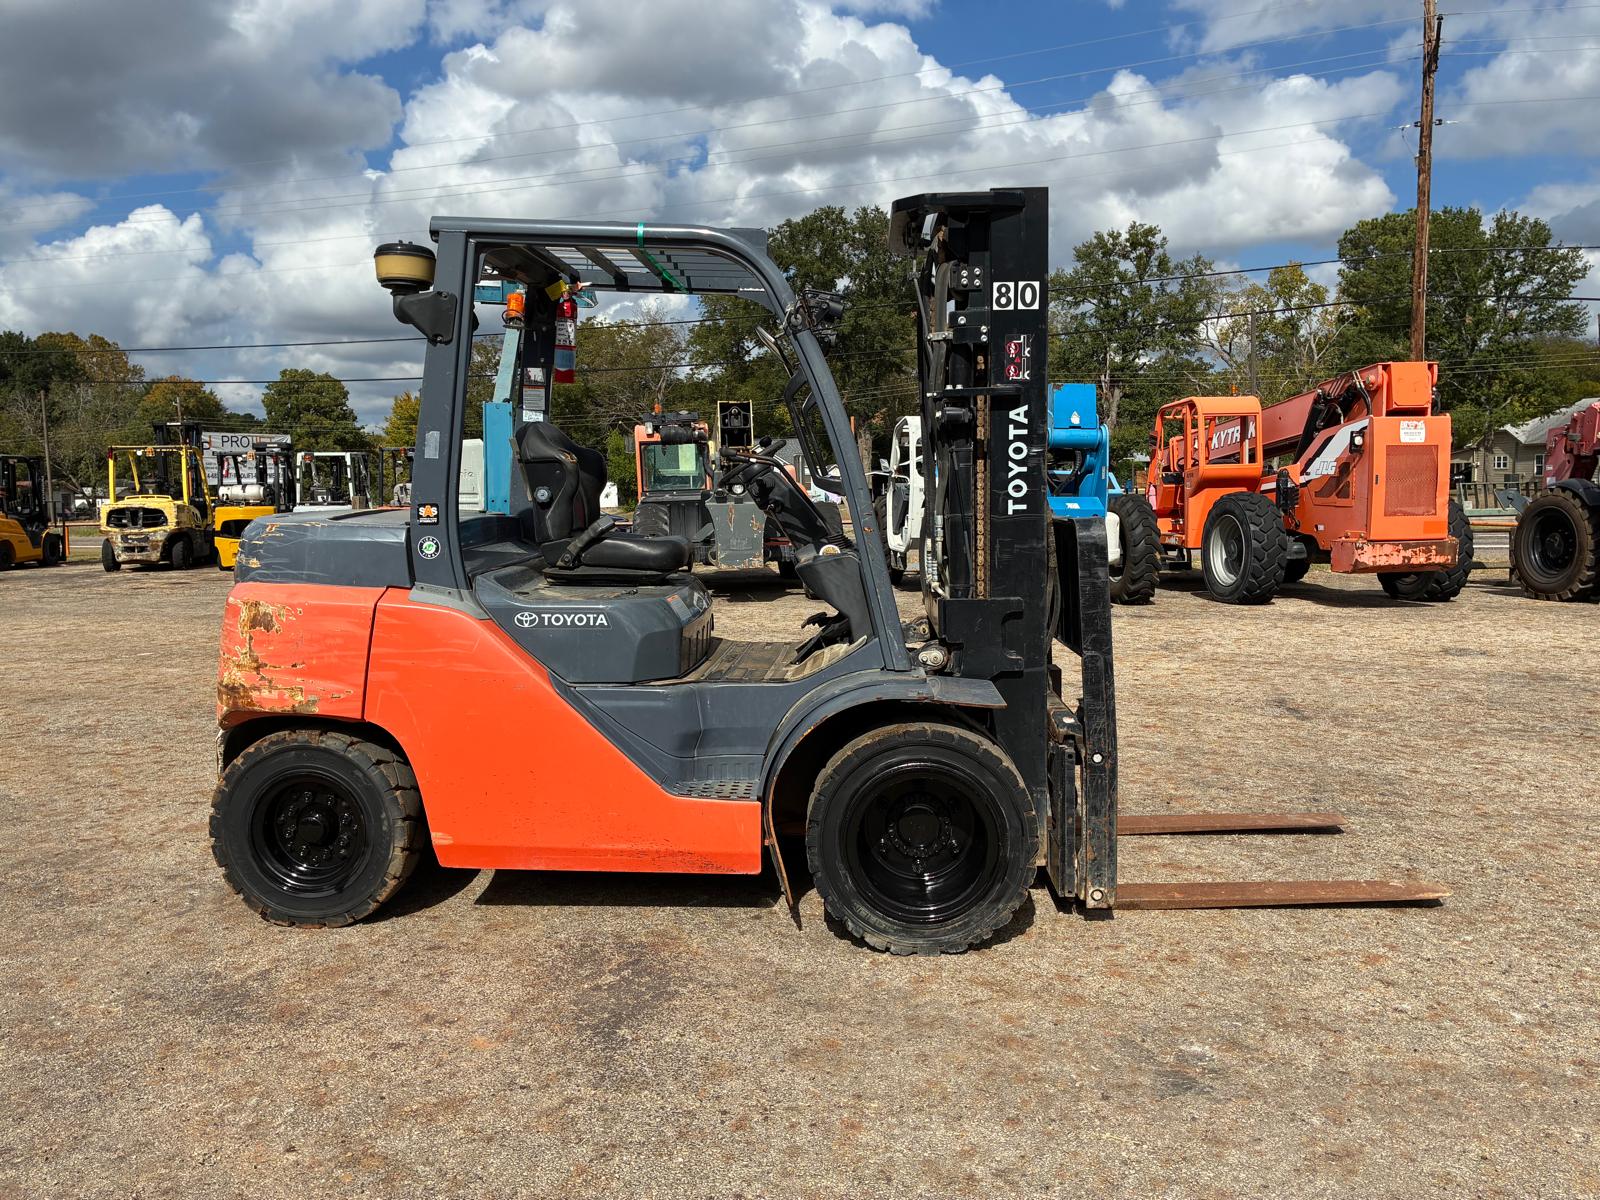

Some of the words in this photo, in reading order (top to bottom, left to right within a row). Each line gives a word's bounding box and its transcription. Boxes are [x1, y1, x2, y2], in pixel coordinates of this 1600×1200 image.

[995, 283, 1037, 308] 80
[1194, 421, 1256, 450] KYTRK
[1007, 404, 1029, 515] TOYOTA
[1315, 461, 1337, 475] JLG
[418, 505, 438, 517] SAS
[541, 614, 608, 626] TOYOTA
